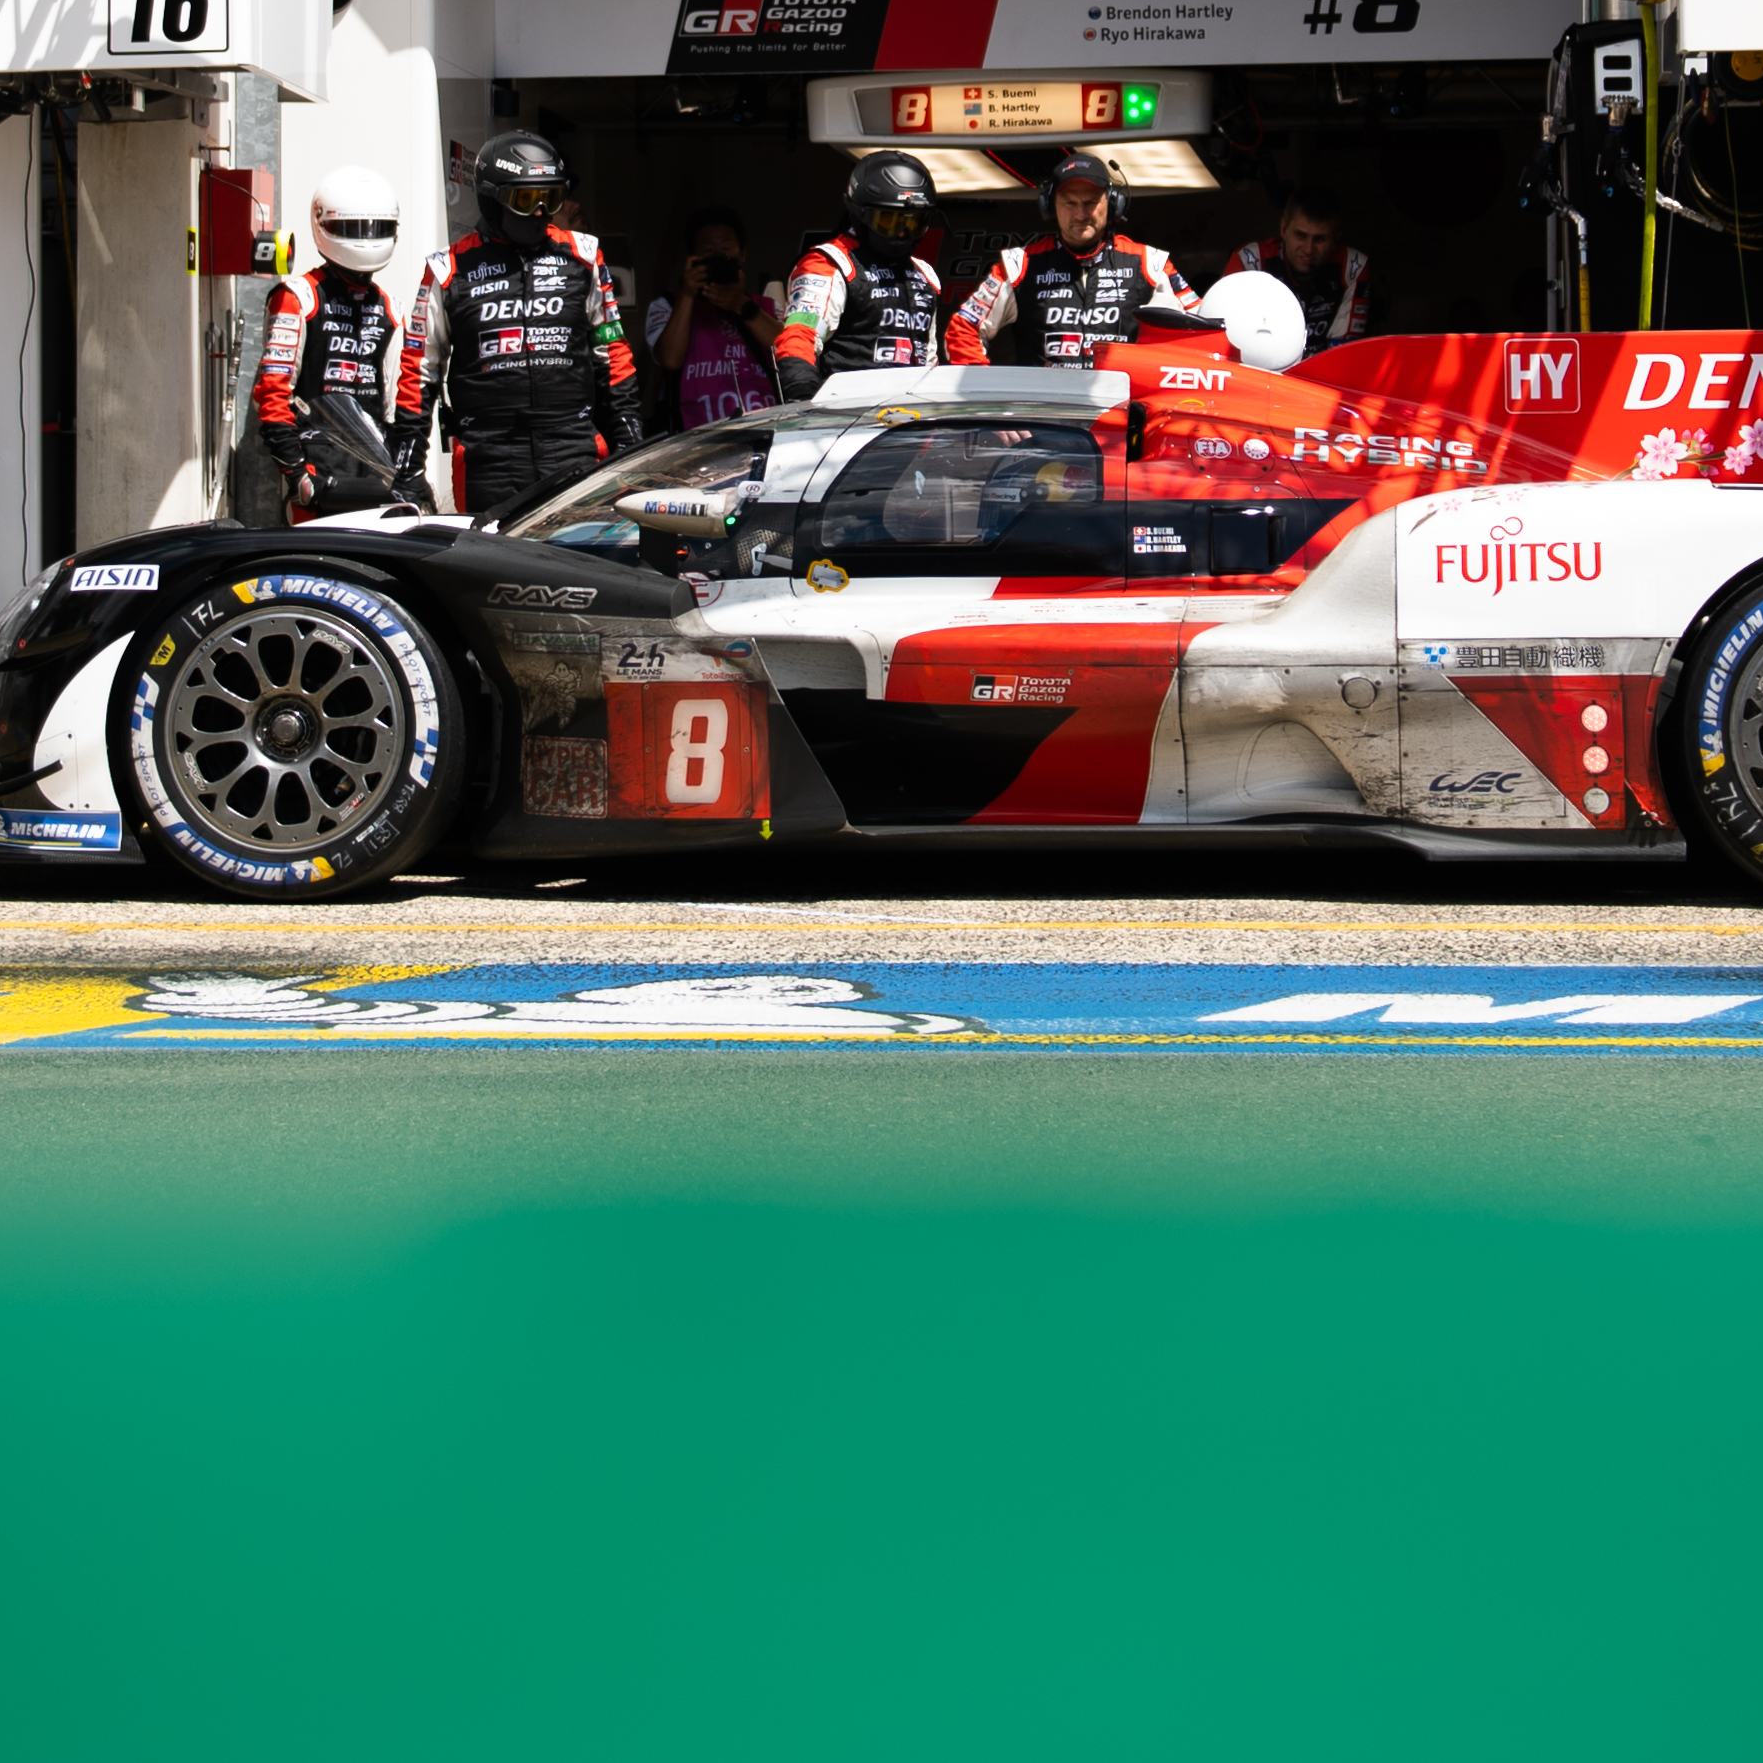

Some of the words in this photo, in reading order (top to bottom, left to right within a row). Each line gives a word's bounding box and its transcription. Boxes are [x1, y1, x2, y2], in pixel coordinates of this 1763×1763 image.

[683, 9, 758, 34] GR
[766, 7, 847, 21] GAZOO
[1106, 5, 1173, 21] Brendon
[1175, 3, 1233, 22] Hartley
[763, 19, 843, 36] Racing
[1100, 26, 1130, 44] Ryo
[1134, 25, 1206, 42] Hirakawa
[690, 43, 731, 55] Pushing
[736, 43, 753, 53] the
[757, 42, 788, 52] limits
[792, 41, 808, 51] for
[813, 40, 847, 51] Better
[988, 89, 999, 98] S.
[1003, 87, 1037, 98] Buemi
[897, 92, 931, 128] 8
[989, 103, 999, 113] B.
[1003, 102, 1041, 115] Hartley
[1085, 89, 1118, 125] 8
[989, 118, 1000, 128] R.
[1003, 117, 1053, 127] Hirakawa
[495, 156, 524, 175] uvex
[255, 242, 277, 261] 8
[467, 263, 507, 283] FUJITSU
[1036, 272, 1071, 286] FUJITSU
[1096, 279, 1124, 288] ZENT
[471, 280, 510, 298] AISIN
[1036, 289, 1073, 300] AISIN
[479, 297, 564, 322] DENSO
[1045, 306, 1120, 325] DENSO
[481, 336, 522, 355] GR
[526, 327, 572, 335] TOYOTA
[525, 334, 570, 344] GAZOO
[1046, 340, 1083, 357] GR
[1084, 334, 1129, 342] TOYOTA
[686, 359, 740, 381] PITLANE
[1159, 366, 1232, 392] ZENT
[1511, 353, 1574, 400] HY
[1196, 439, 1230, 457] FIA
[1293, 428, 1475, 457] RACING
[1293, 443, 1488, 475] HYBRID
[644, 502, 689, 517] Mobil
[75, 568, 156, 587] AISIN
[1435, 542, 1602, 597] FUJITSU
[280, 578, 394, 631] MICHELIN
[488, 583, 598, 609] RAYS
[191, 599, 225, 627] FL
[156, 645, 171, 660] M
[313, 628, 352, 655] RAYS
[399, 641, 421, 674] PILOT
[415, 676, 434, 718] SPORT
[972, 684, 1016, 700] GR
[1020, 676, 1072, 686] TOYOTA
[1018, 685, 1067, 694] GAZOO
[1017, 693, 1065, 704] Racing
[529, 744, 599, 770] HYPER
[666, 699, 728, 804] 8
[139, 743, 153, 784] SPORT
[531, 768, 600, 809] CAR
[1429, 771, 1522, 794] WEC
[147, 785, 169, 818] PILOT
[10, 819, 107, 840] MICHELIN
[174, 827, 288, 883] MICHELIN
